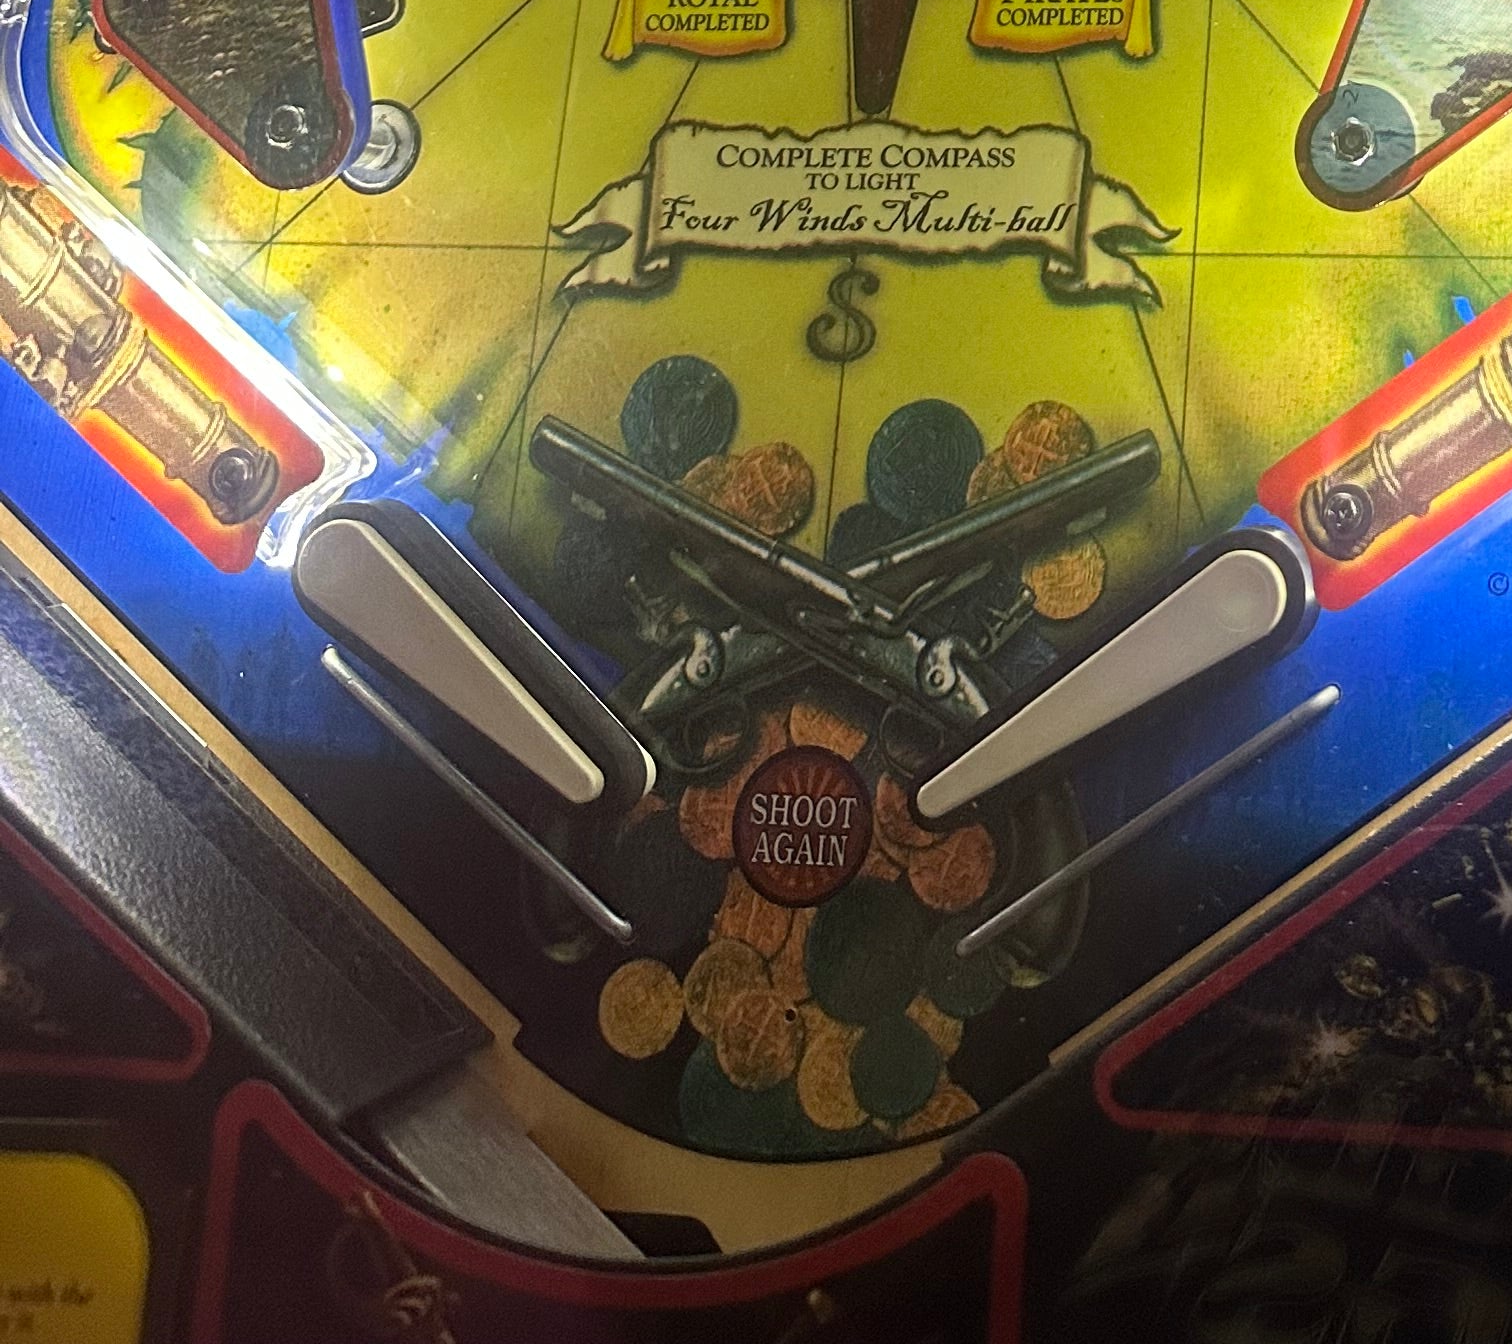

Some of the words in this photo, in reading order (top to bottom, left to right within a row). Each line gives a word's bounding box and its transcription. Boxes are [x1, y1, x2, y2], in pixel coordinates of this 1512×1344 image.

[645, 13, 770, 32] COMPLETED
[996, 7, 1125, 28] COMPLETED
[716, 143, 873, 170] COMPLETE
[880, 143, 1017, 170] COMPASS
[805, 172, 840, 191] TO
[845, 172, 922, 192] LIGHT
[659, 194, 740, 235] Four
[750, 196, 866, 235] Winds
[873, 189, 1079, 235] Multi-ball
[751, 793, 858, 829] SHOOT
[751, 831, 848, 867] AGAIN
